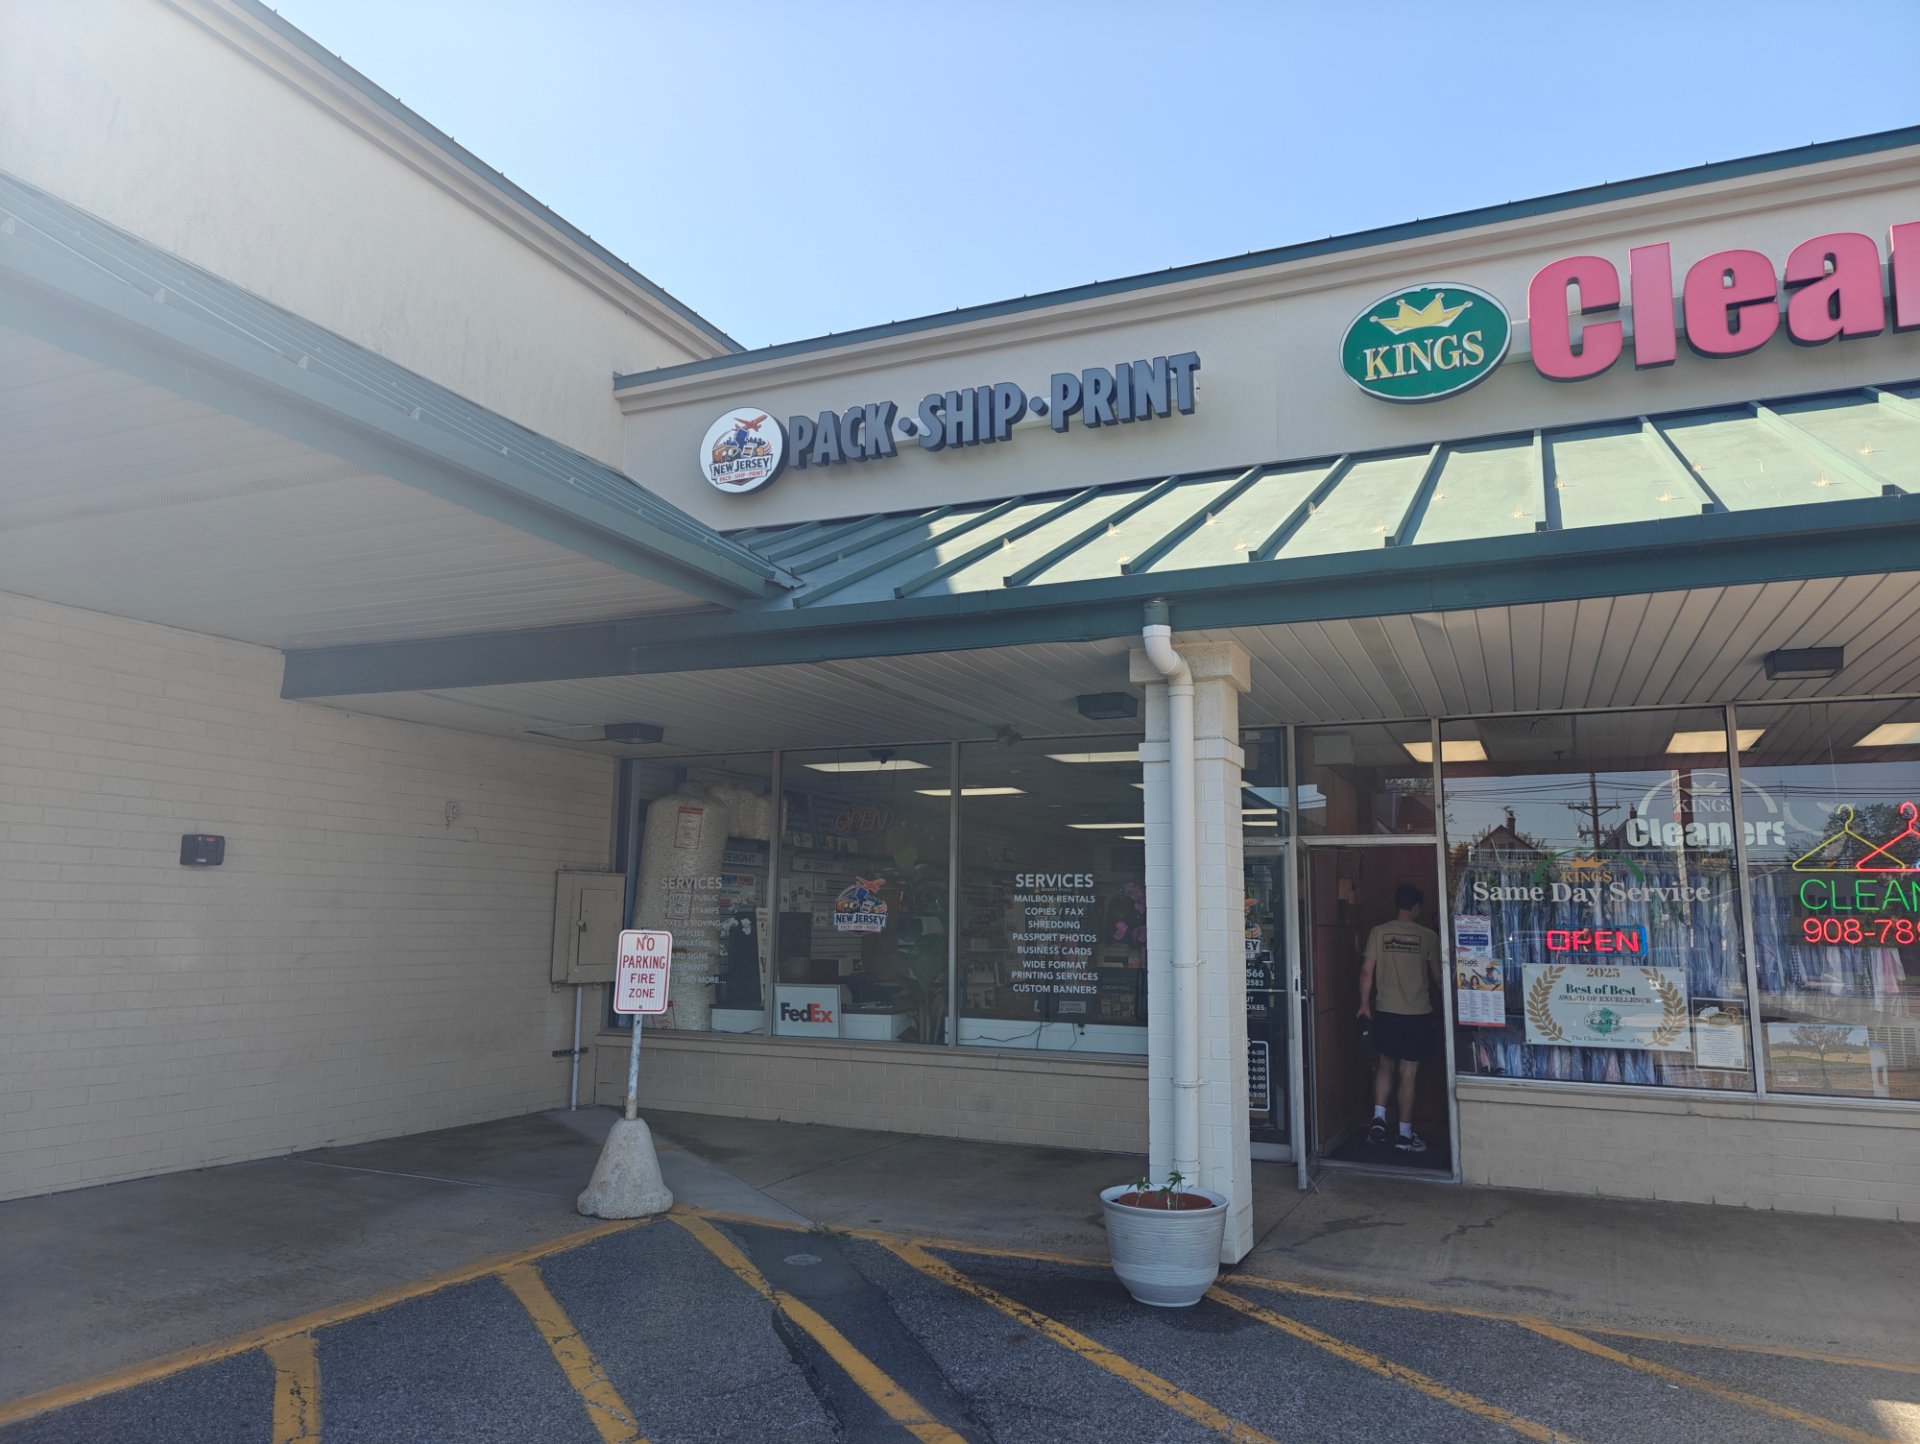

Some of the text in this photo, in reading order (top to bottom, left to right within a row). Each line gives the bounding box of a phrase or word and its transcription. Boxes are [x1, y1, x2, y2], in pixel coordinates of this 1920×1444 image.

[1363, 331, 1485, 382] KINGS
[788, 351, 1201, 470] PACK SHIP PRINT
[713, 457, 770, 476] NEW JERSEY
[661, 876, 723, 890] SERVICES
[1015, 873, 1095, 889] SERVICES
[1561, 871, 1613, 884] KINGS
[1014, 894, 1096, 904] MAILBOX RENTALS
[1472, 881, 1712, 906] Same Day Service
[690, 906, 720, 914] STAMPS
[1024, 907, 1057, 916] COPIES
[1064, 907, 1085, 916] FAX
[690, 919, 721, 927] MOVING
[836, 914, 885, 925] NEW JERSEY
[1027, 920, 1081, 930] SHREDDING
[672, 929, 705, 937] SUPPLIES
[1802, 917, 1920, 944] 908-78
[1012, 932, 1097, 943] PASSPORT PHOTOS
[1546, 929, 1641, 954] OPEN
[636, 937, 656, 951] NO
[672, 940, 711, 948] AMINATING
[687, 952, 709, 960] SIGNS
[1017, 945, 1093, 956] BUSINESS CARDS
[623, 955, 666, 969] PARKING
[1022, 960, 1087, 970] WIDE FORMAT
[1011, 970, 1054, 980] PRINTING
[1055, 971, 1099, 981] SERVICES
[1586, 967, 1620, 978] 2025
[630, 973, 656, 984] FIRE
[628, 988, 655, 998] ZONE
[1012, 983, 1098, 995] CUSTOM BANNERS
[1566, 984, 1636, 996] Best of Best
[1599, 995, 1651, 1003] EXCELLENCE
[780, 1002, 834, 1023] FedEx
